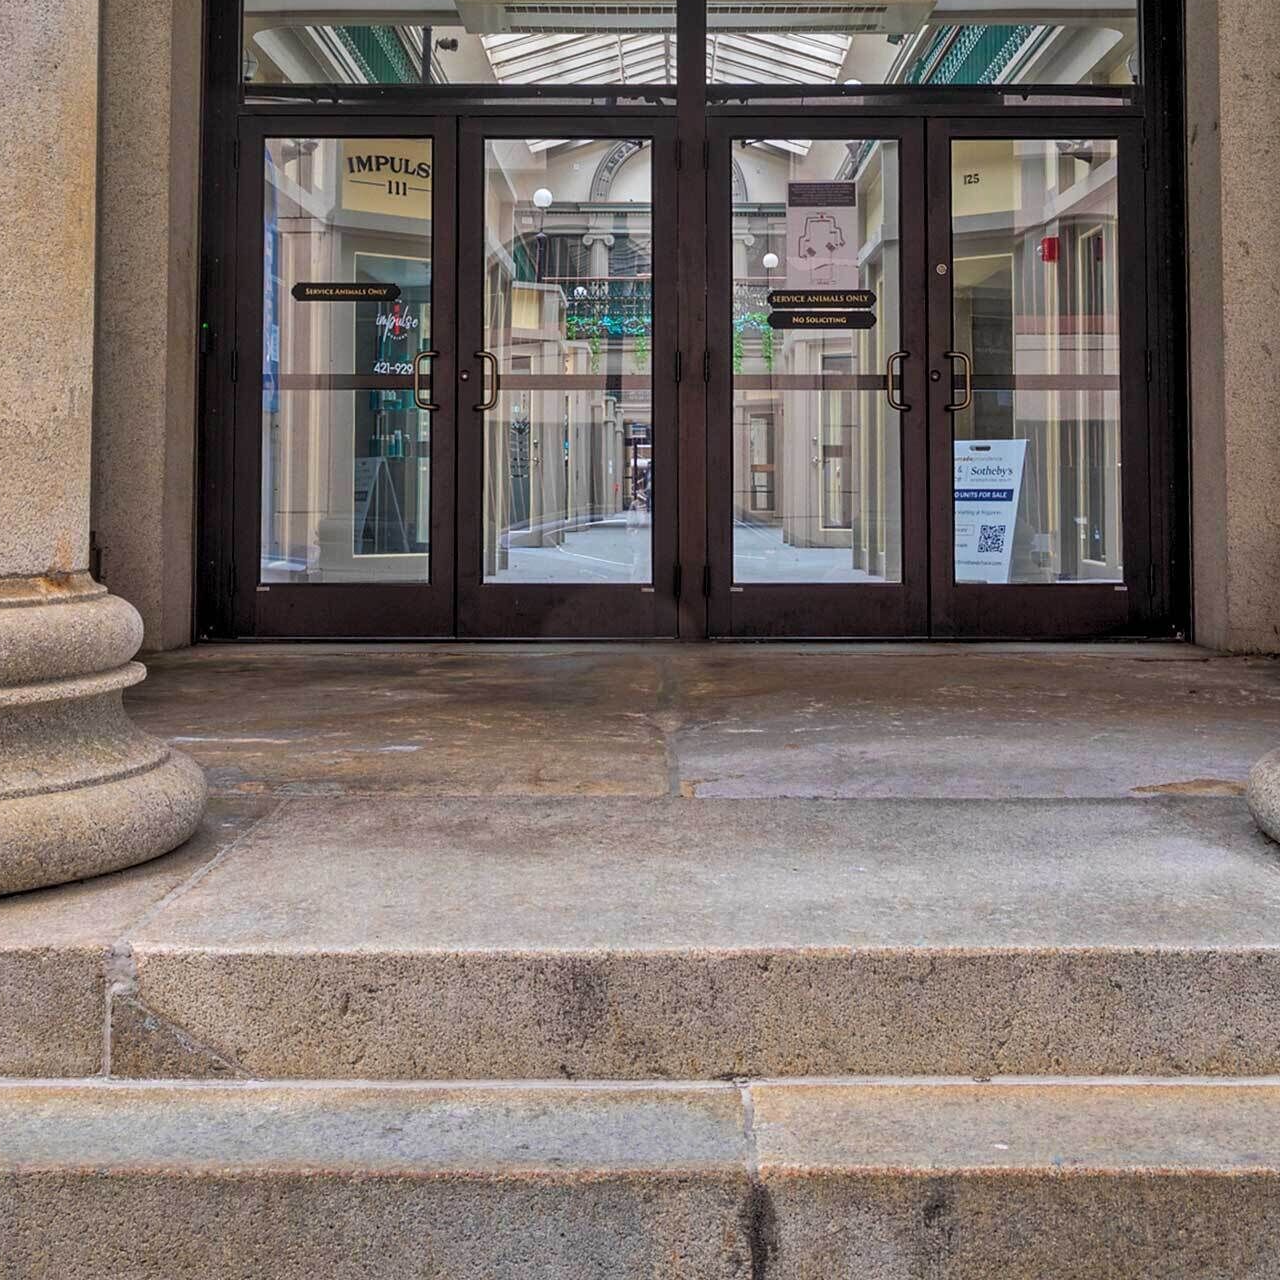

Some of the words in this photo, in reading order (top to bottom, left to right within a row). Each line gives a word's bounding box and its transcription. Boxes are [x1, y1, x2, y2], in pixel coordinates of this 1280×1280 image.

[963, 173, 980, 185] 125
[772, 294, 805, 303] SERVICE
[807, 294, 845, 303] ANIMALS
[845, 294, 869, 303] ONLY
[970, 465, 1013, 478] Sotheby's
